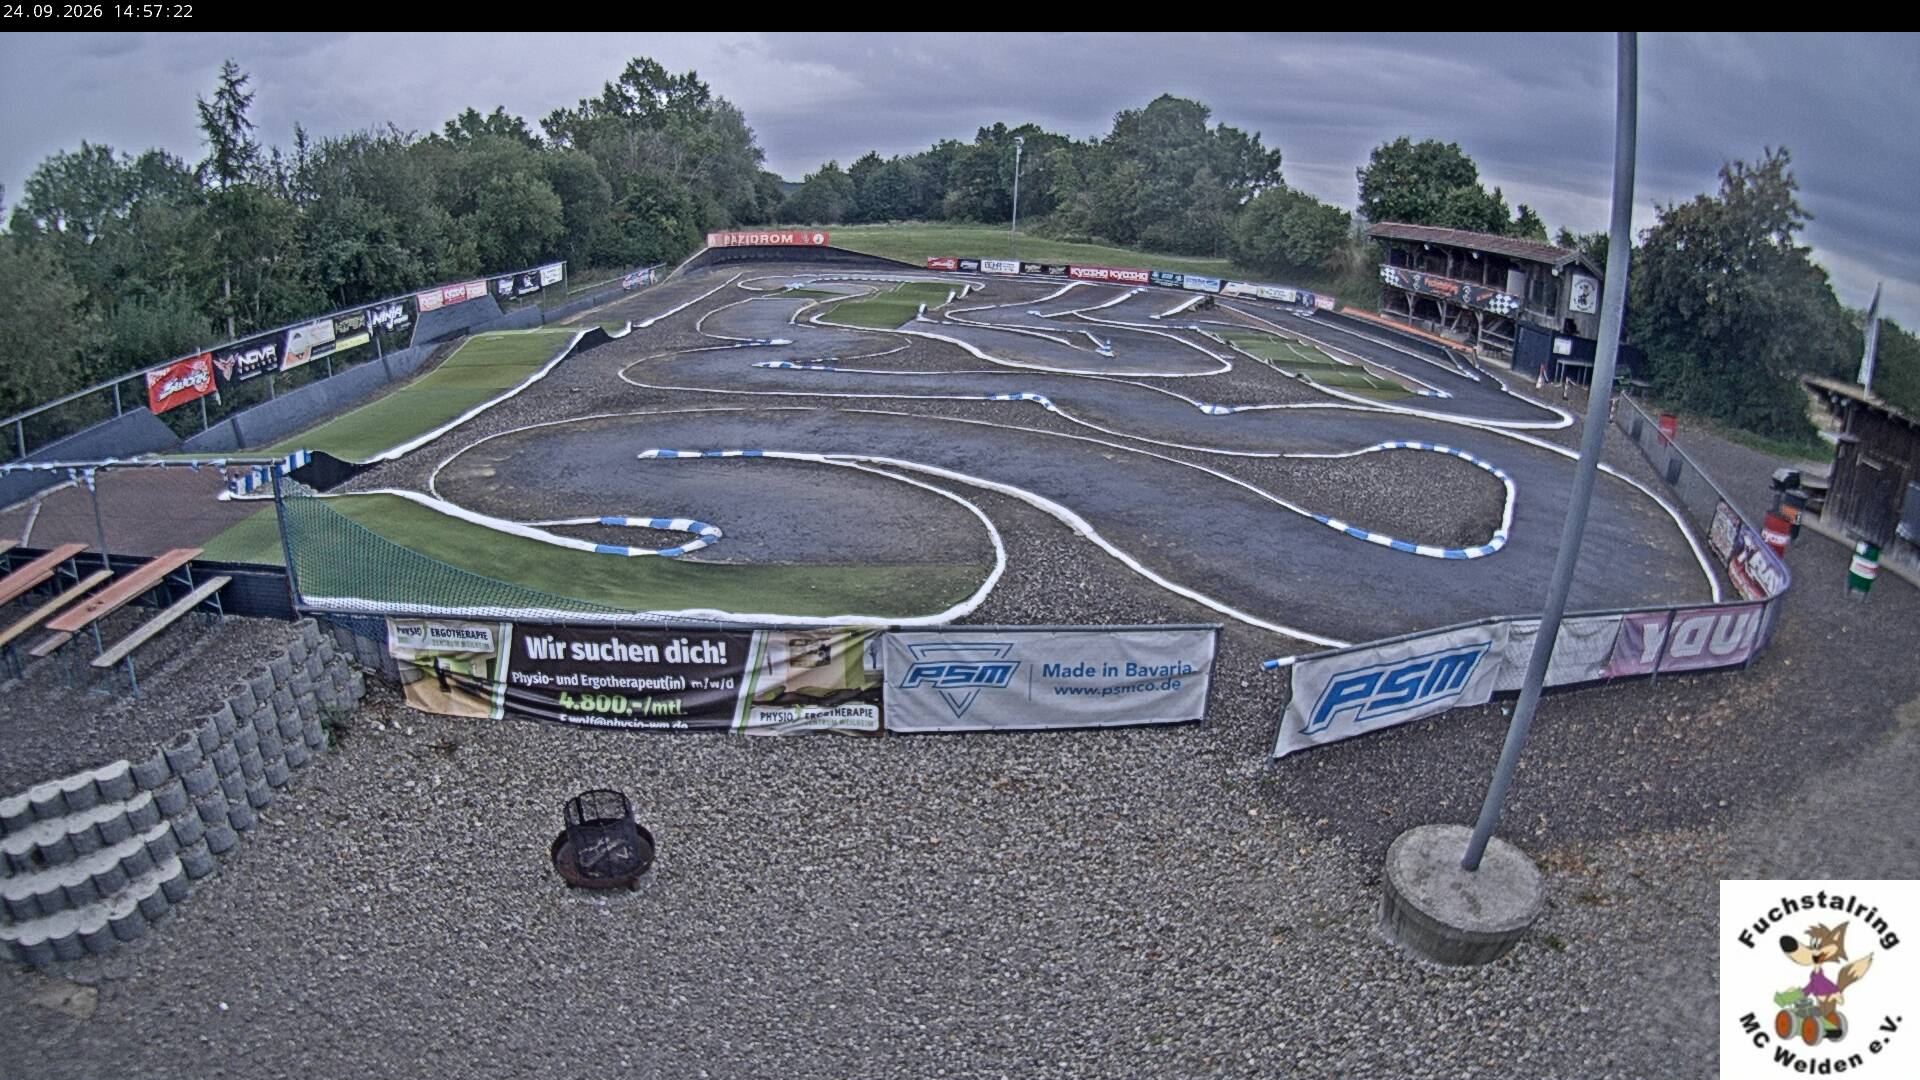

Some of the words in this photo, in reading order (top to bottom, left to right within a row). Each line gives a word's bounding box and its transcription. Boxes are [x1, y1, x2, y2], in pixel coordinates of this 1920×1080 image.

[237, 345, 277, 366] NOVA
[430, 627, 489, 641] ERGOTHERAPIE
[525, 635, 566, 660] Wir
[571, 636, 660, 663] suchen
[664, 637, 728, 665] dich!
[908, 664, 1014, 688] PSM
[1042, 663, 1095, 678] Made
[1103, 663, 1121, 678] in
[1127, 660, 1193, 678] Bavaria
[511, 671, 554, 688] Physio-
[556, 673, 578, 687] und
[581, 674, 686, 691] Ergotherapeut(in)
[691, 677, 735, 690] m/w/d
[1054, 679, 1182, 697] www.psmco.de
[1311, 649, 1482, 725] PSM
[760, 711, 794, 723] PHYSIO
